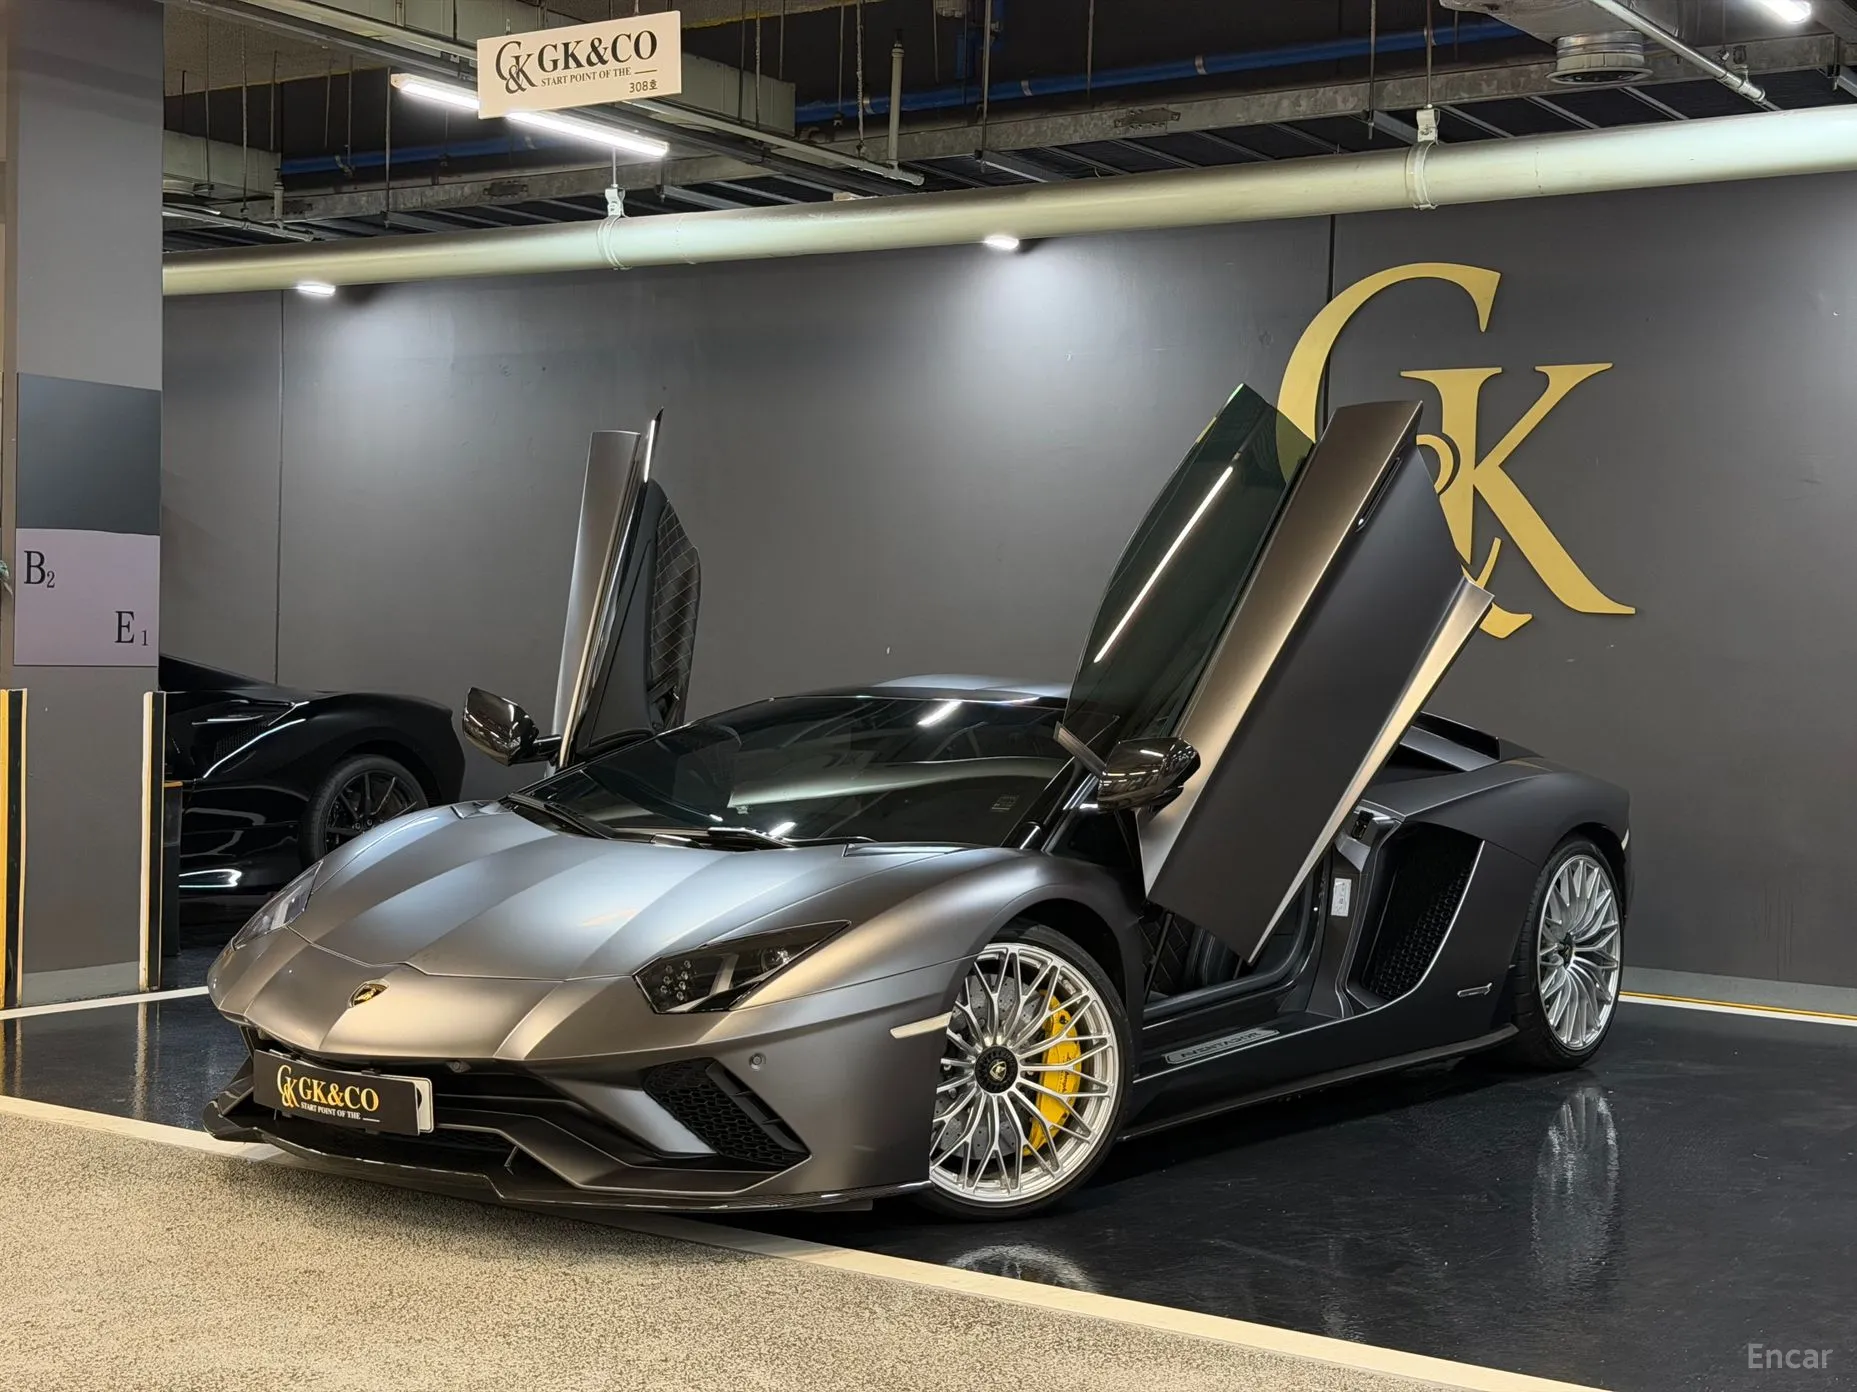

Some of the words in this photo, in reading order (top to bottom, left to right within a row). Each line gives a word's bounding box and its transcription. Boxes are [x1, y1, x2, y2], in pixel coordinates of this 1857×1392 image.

[537, 30, 658, 74] GK&CO
[541, 75, 569, 88] START
[569, 71, 598, 84] POINT
[599, 69, 612, 80] OF
[613, 66, 632, 78] THE
[629, 79, 658, 94] 308호
[298, 1076, 380, 1112] GK&CO
[300, 1101, 317, 1113] START
[317, 1105, 336, 1117] POINT
[336, 1109, 346, 1118] OF
[347, 1111, 361, 1120] THE
